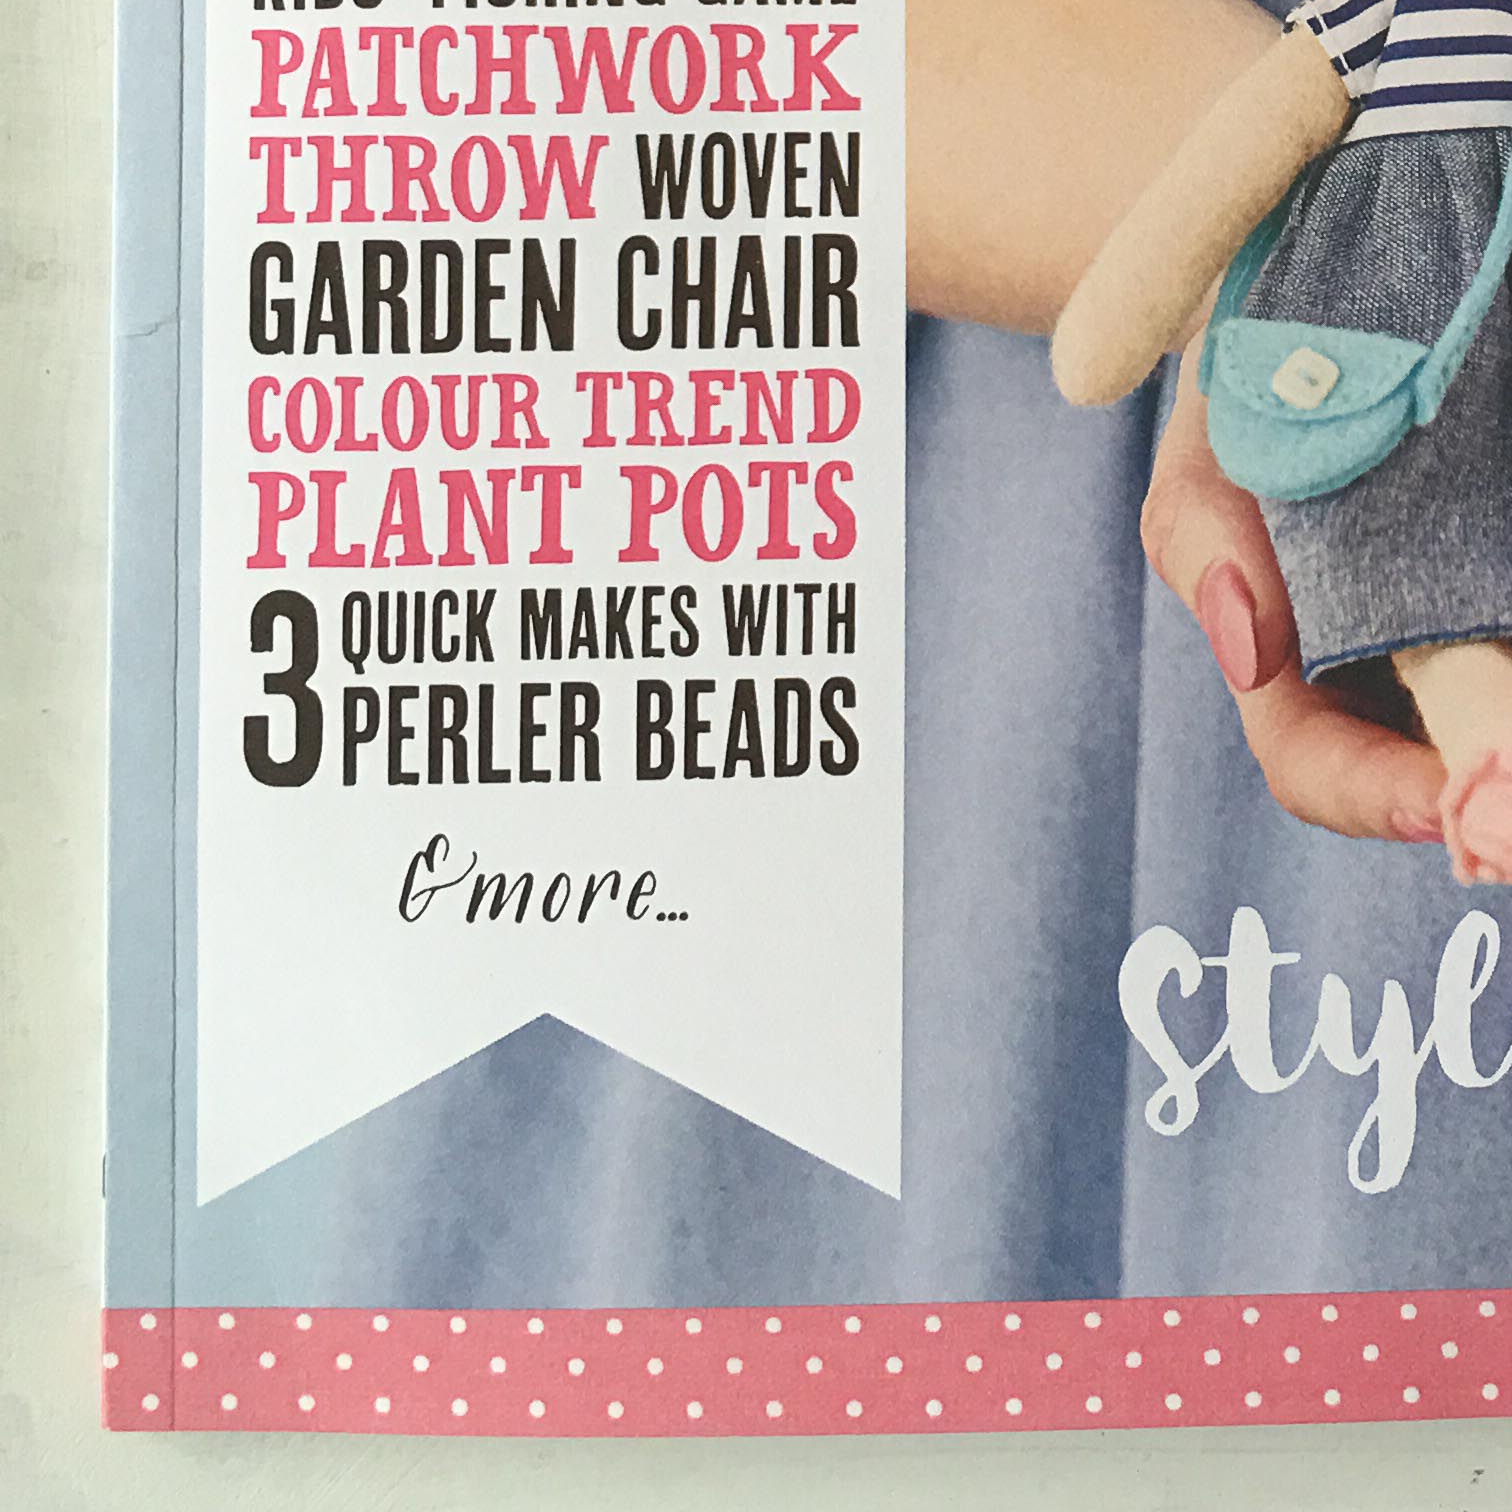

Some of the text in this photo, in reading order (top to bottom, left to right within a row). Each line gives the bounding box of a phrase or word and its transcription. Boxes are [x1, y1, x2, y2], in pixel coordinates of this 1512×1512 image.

[250, 24, 861, 117] PATCHWORK
[249, 131, 861, 223] THROW WOVEN
[250, 233, 860, 355] GARDEN CHAIR
[247, 368, 862, 453] COLOUR TREND
[246, 460, 858, 569] PLANT POTS
[342, 582, 857, 674] QUICK MAKES WITH
[243, 589, 324, 787] 3
[342, 676, 860, 786] PERLER BEADS
